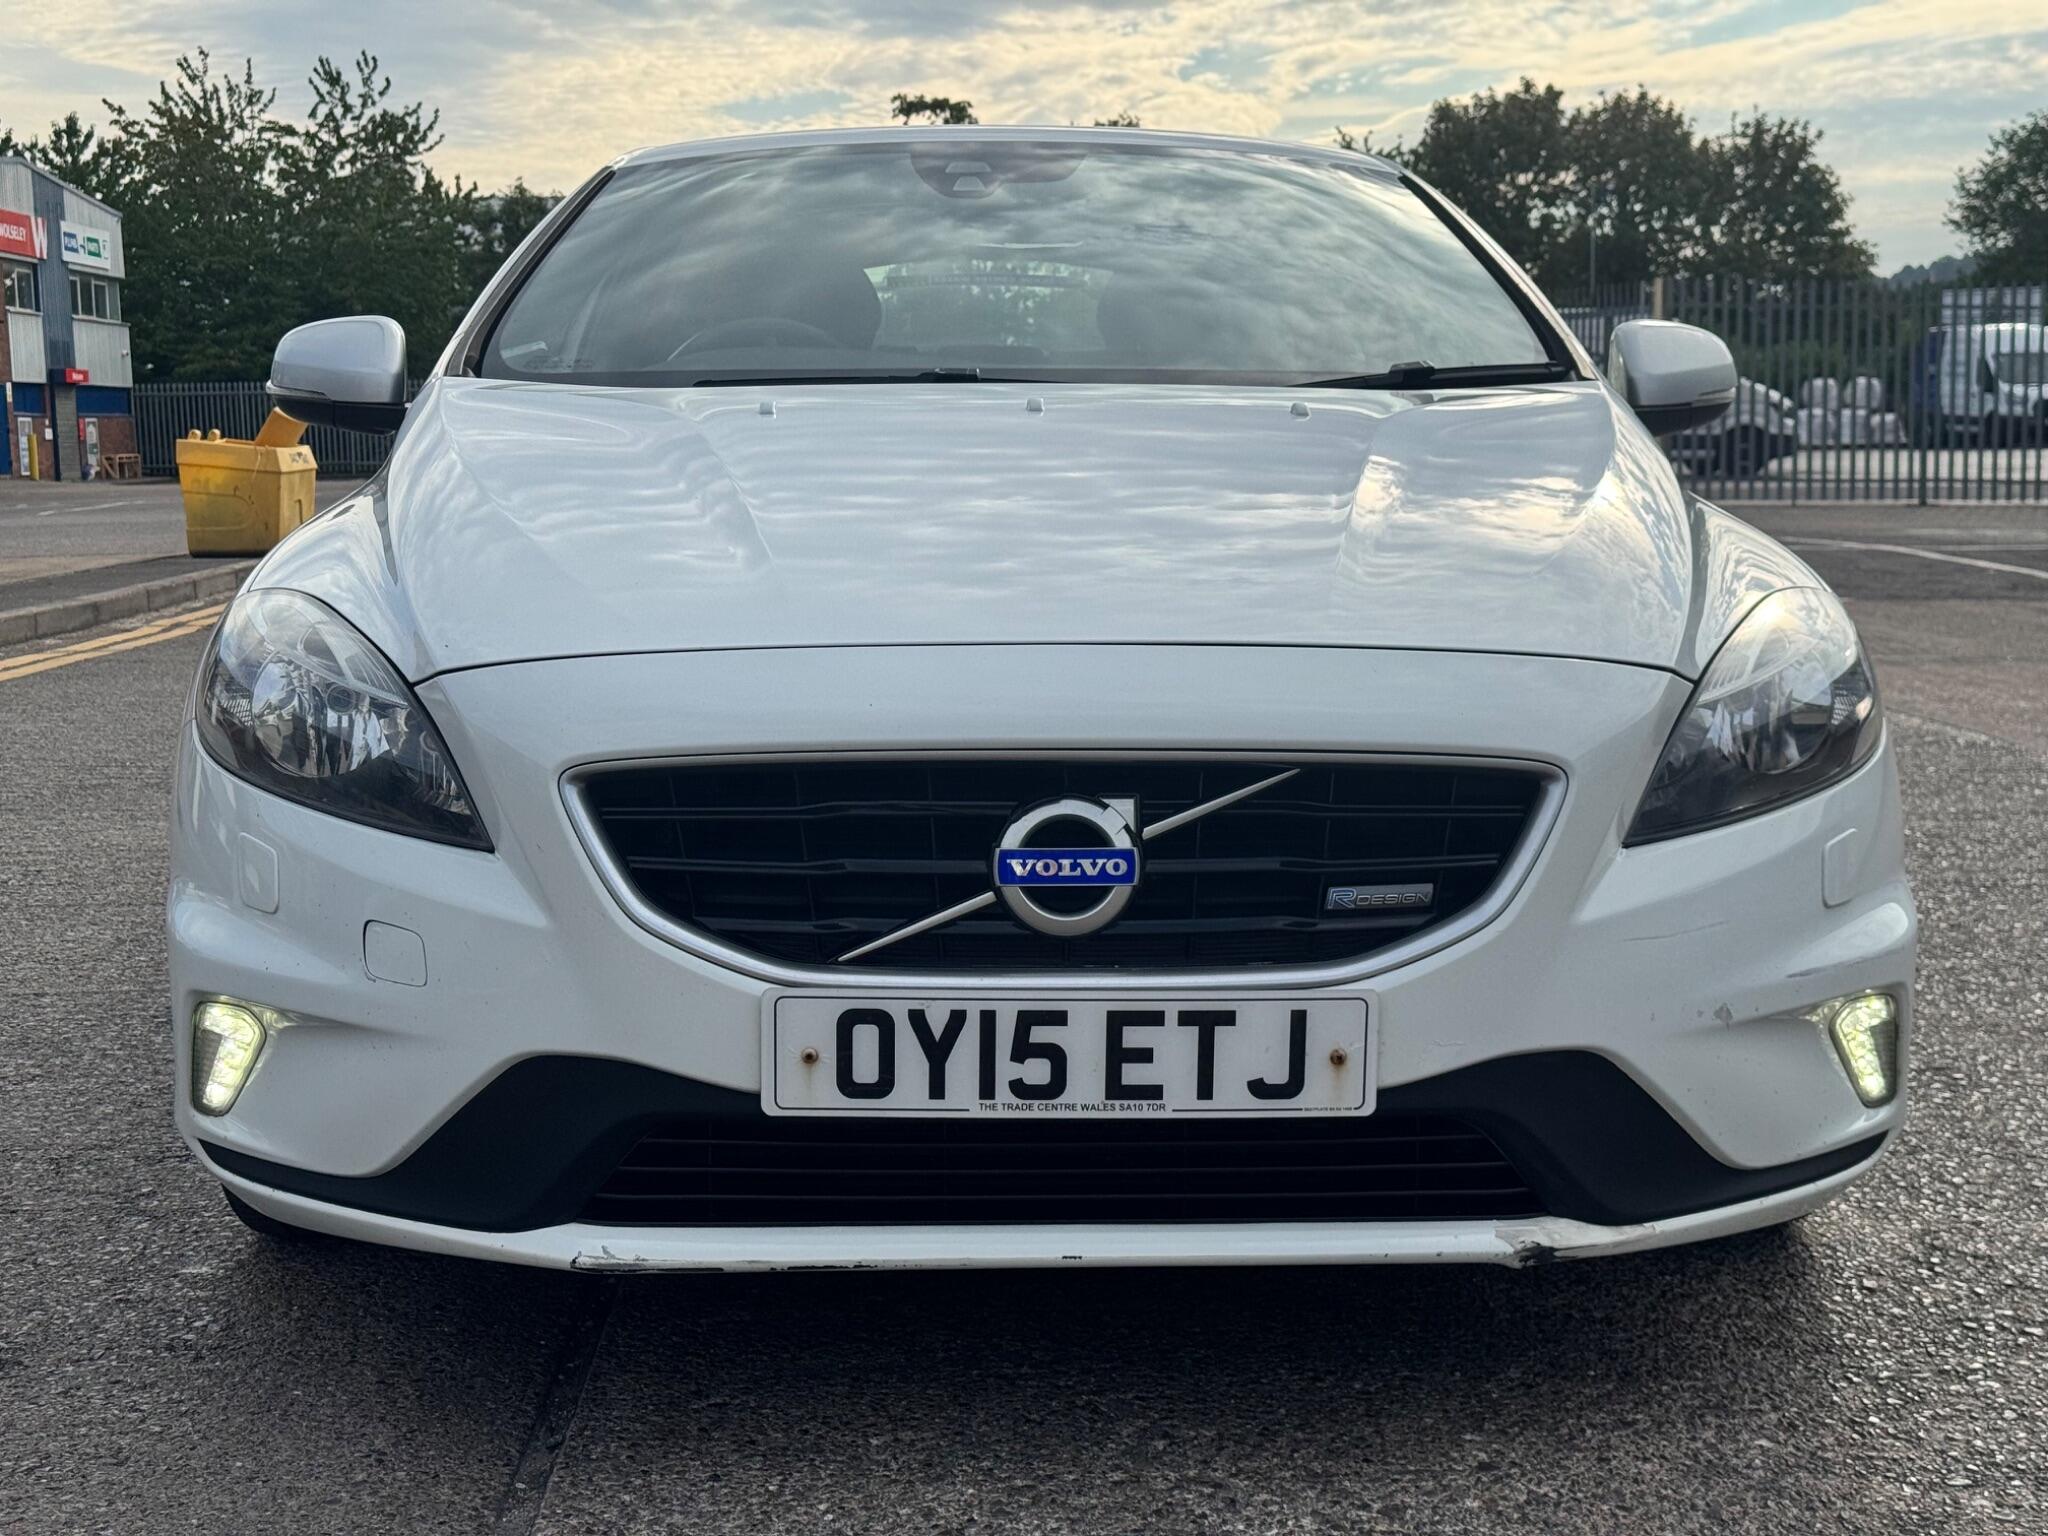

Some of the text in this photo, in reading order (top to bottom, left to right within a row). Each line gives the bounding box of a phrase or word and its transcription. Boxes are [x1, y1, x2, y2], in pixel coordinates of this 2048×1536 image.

[1006, 858, 1128, 877] VOLVO
[836, 1008, 1307, 1101] OY15 ETJ
[978, 1102, 999, 1112] THE
[1001, 1102, 1035, 1112] TRADE
[1037, 1102, 1078, 1112] CENTRE
[1080, 1102, 1117, 1112] WALES
[1118, 1102, 1144, 1112] SA10
